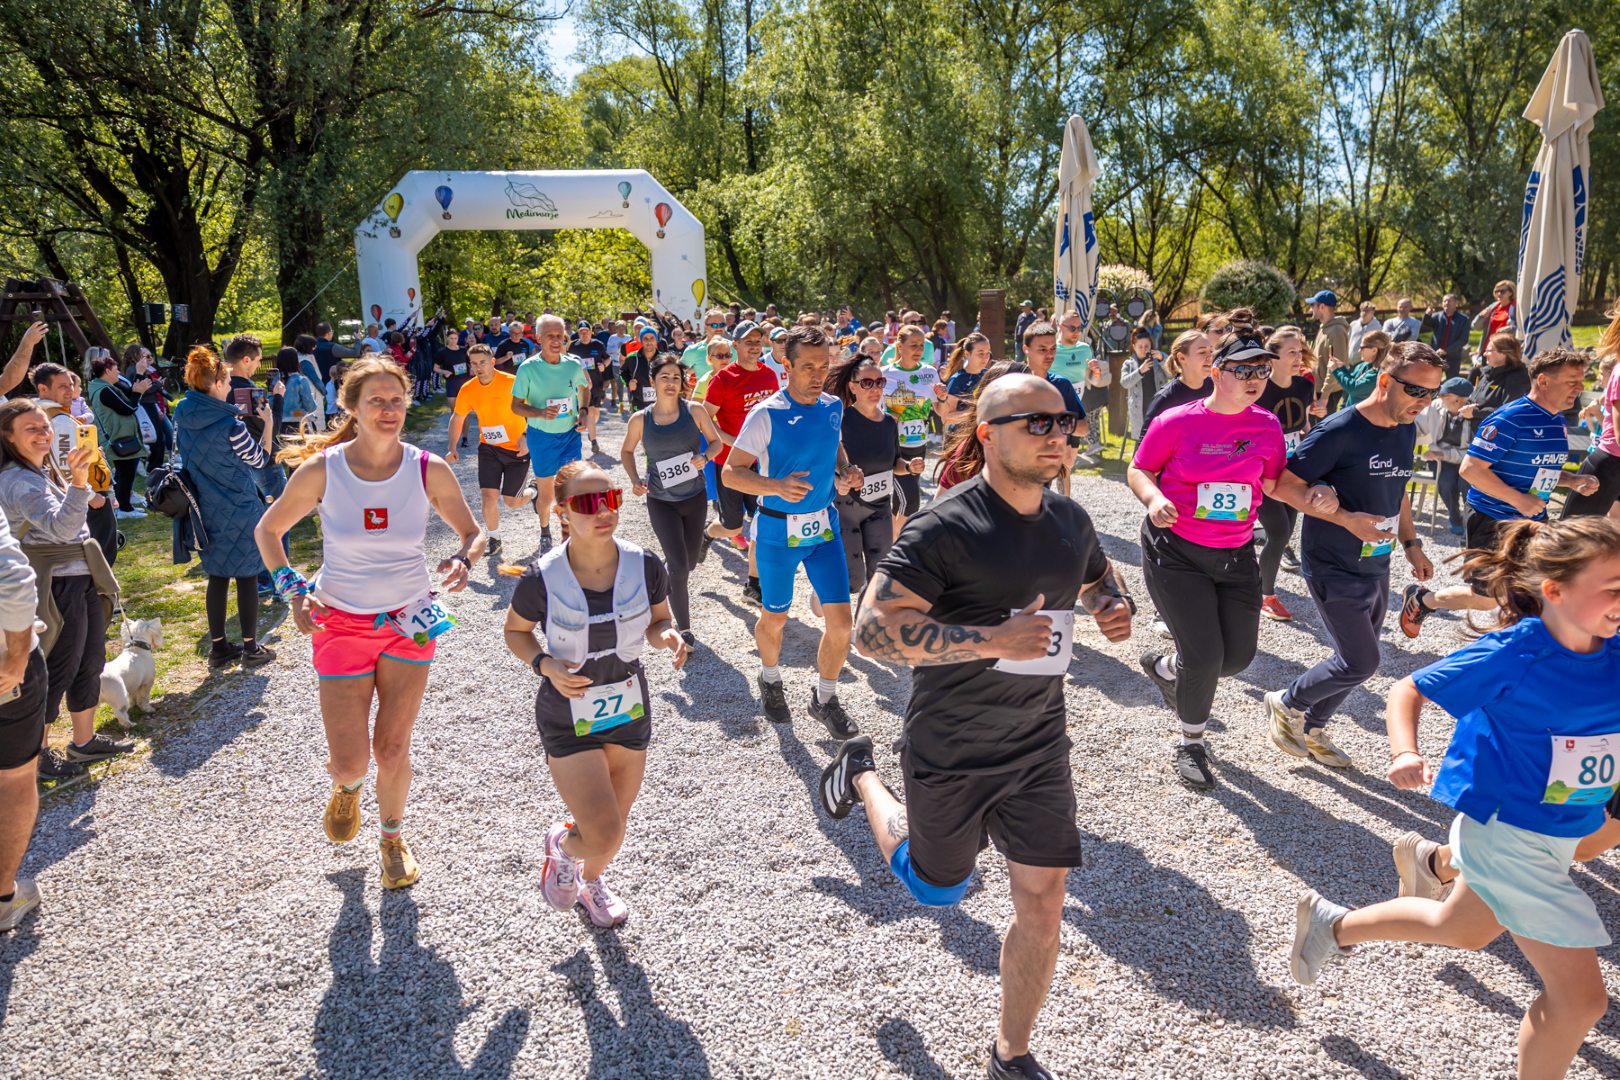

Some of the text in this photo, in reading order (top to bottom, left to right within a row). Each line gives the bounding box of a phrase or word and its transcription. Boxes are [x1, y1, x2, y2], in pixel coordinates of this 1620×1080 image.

[483, 431, 503, 440] 9358
[903, 425, 923, 436] 122
[660, 461, 690, 481] 9386
[861, 479, 888, 497] 9385
[1212, 493, 1237, 510] 83
[801, 520, 820, 537] 69
[411, 603, 446, 630] 138
[592, 694, 624, 718] 27
[1578, 753, 1615, 785] 80
